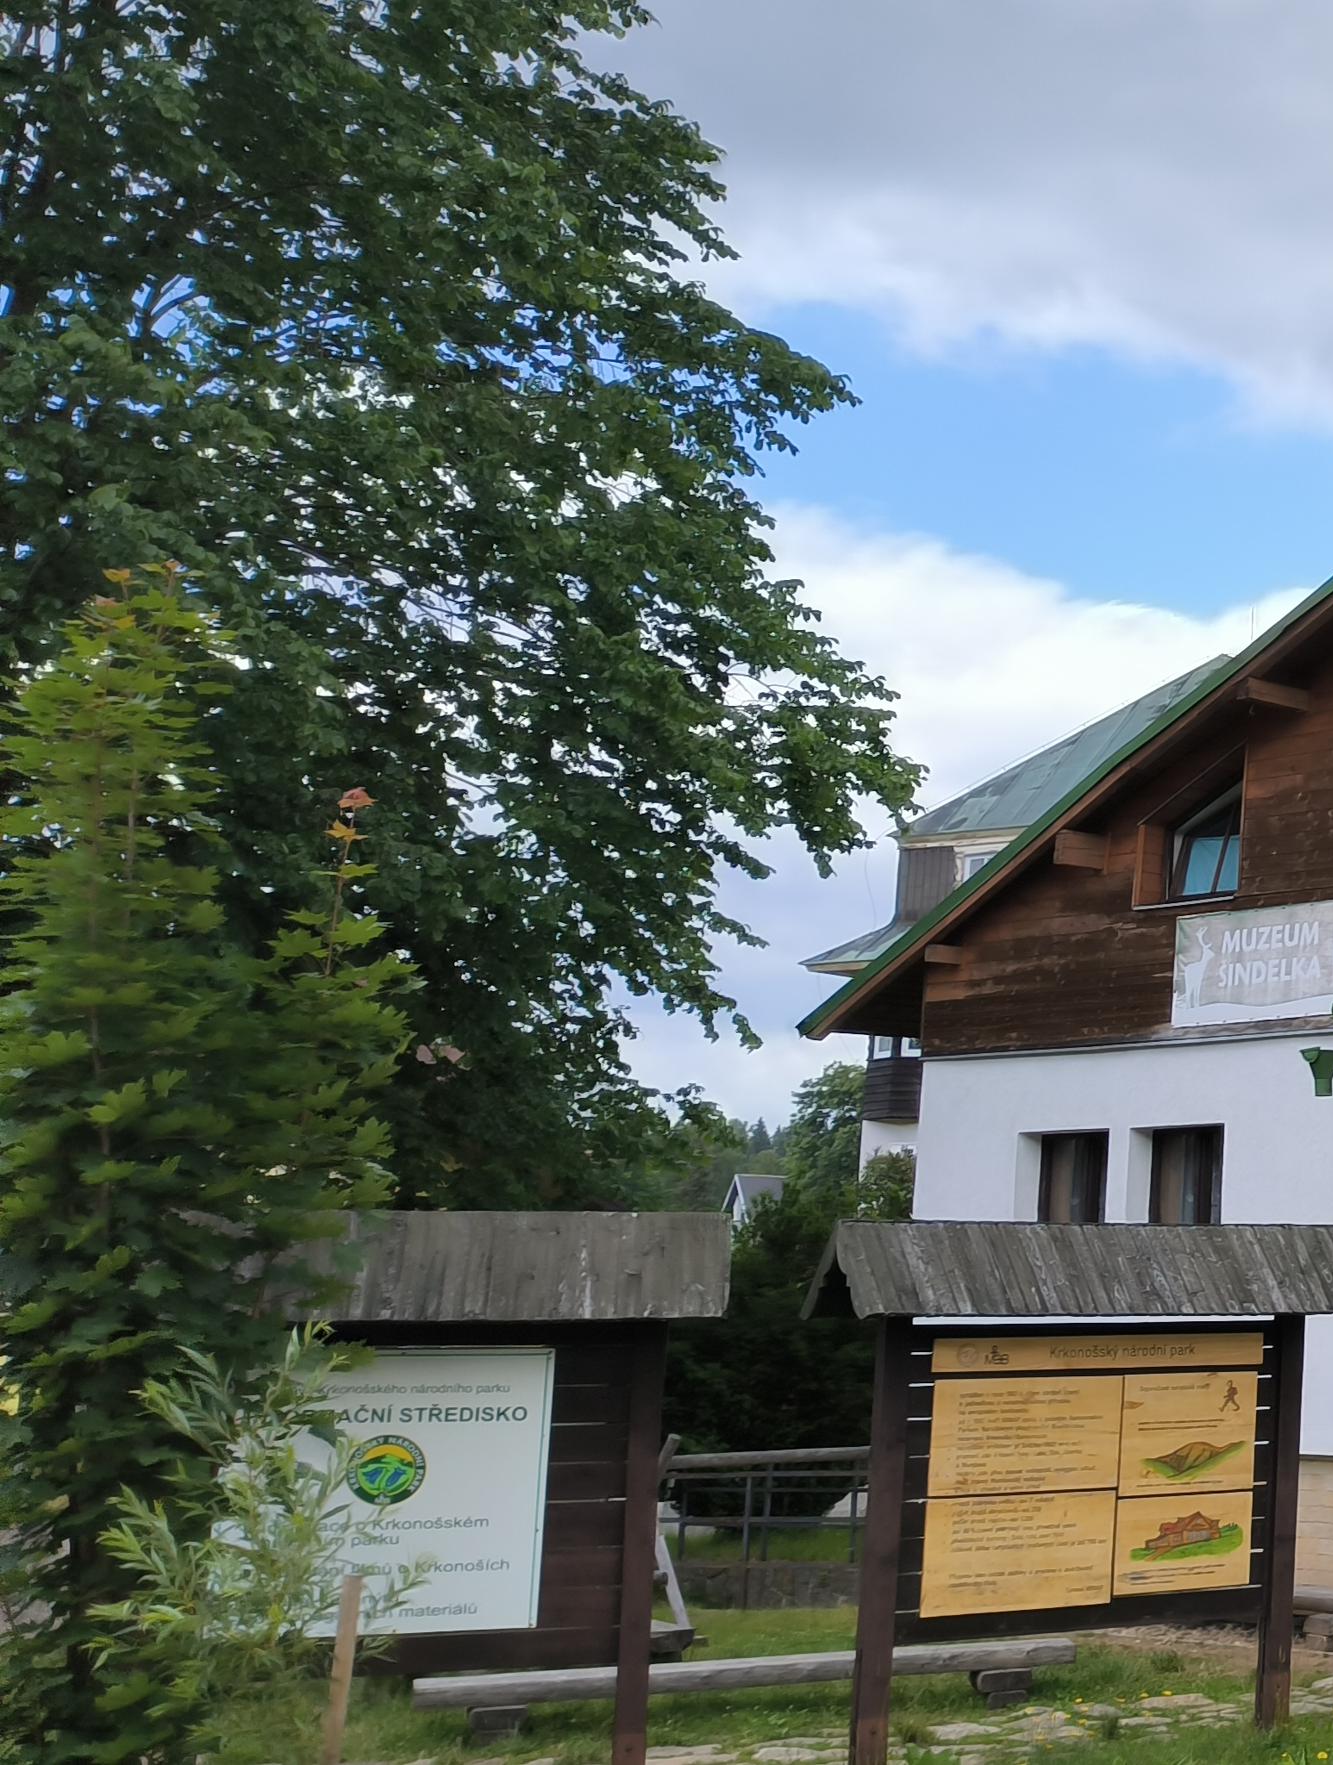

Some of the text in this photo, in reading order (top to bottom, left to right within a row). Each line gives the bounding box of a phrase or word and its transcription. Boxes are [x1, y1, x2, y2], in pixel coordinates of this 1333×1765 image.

[1221, 921, 1320, 954] MUZEUM
[1218, 956, 1321, 988] ŠINDELKA
[1048, 1343, 1196, 1360] Krkonošský národní park
[475, 1384, 511, 1395] parku
[398, 1404, 528, 1424] STŘEDISKO
[372, 1516, 489, 1531] Krkonošském
[398, 1603, 478, 1618] materiálů
